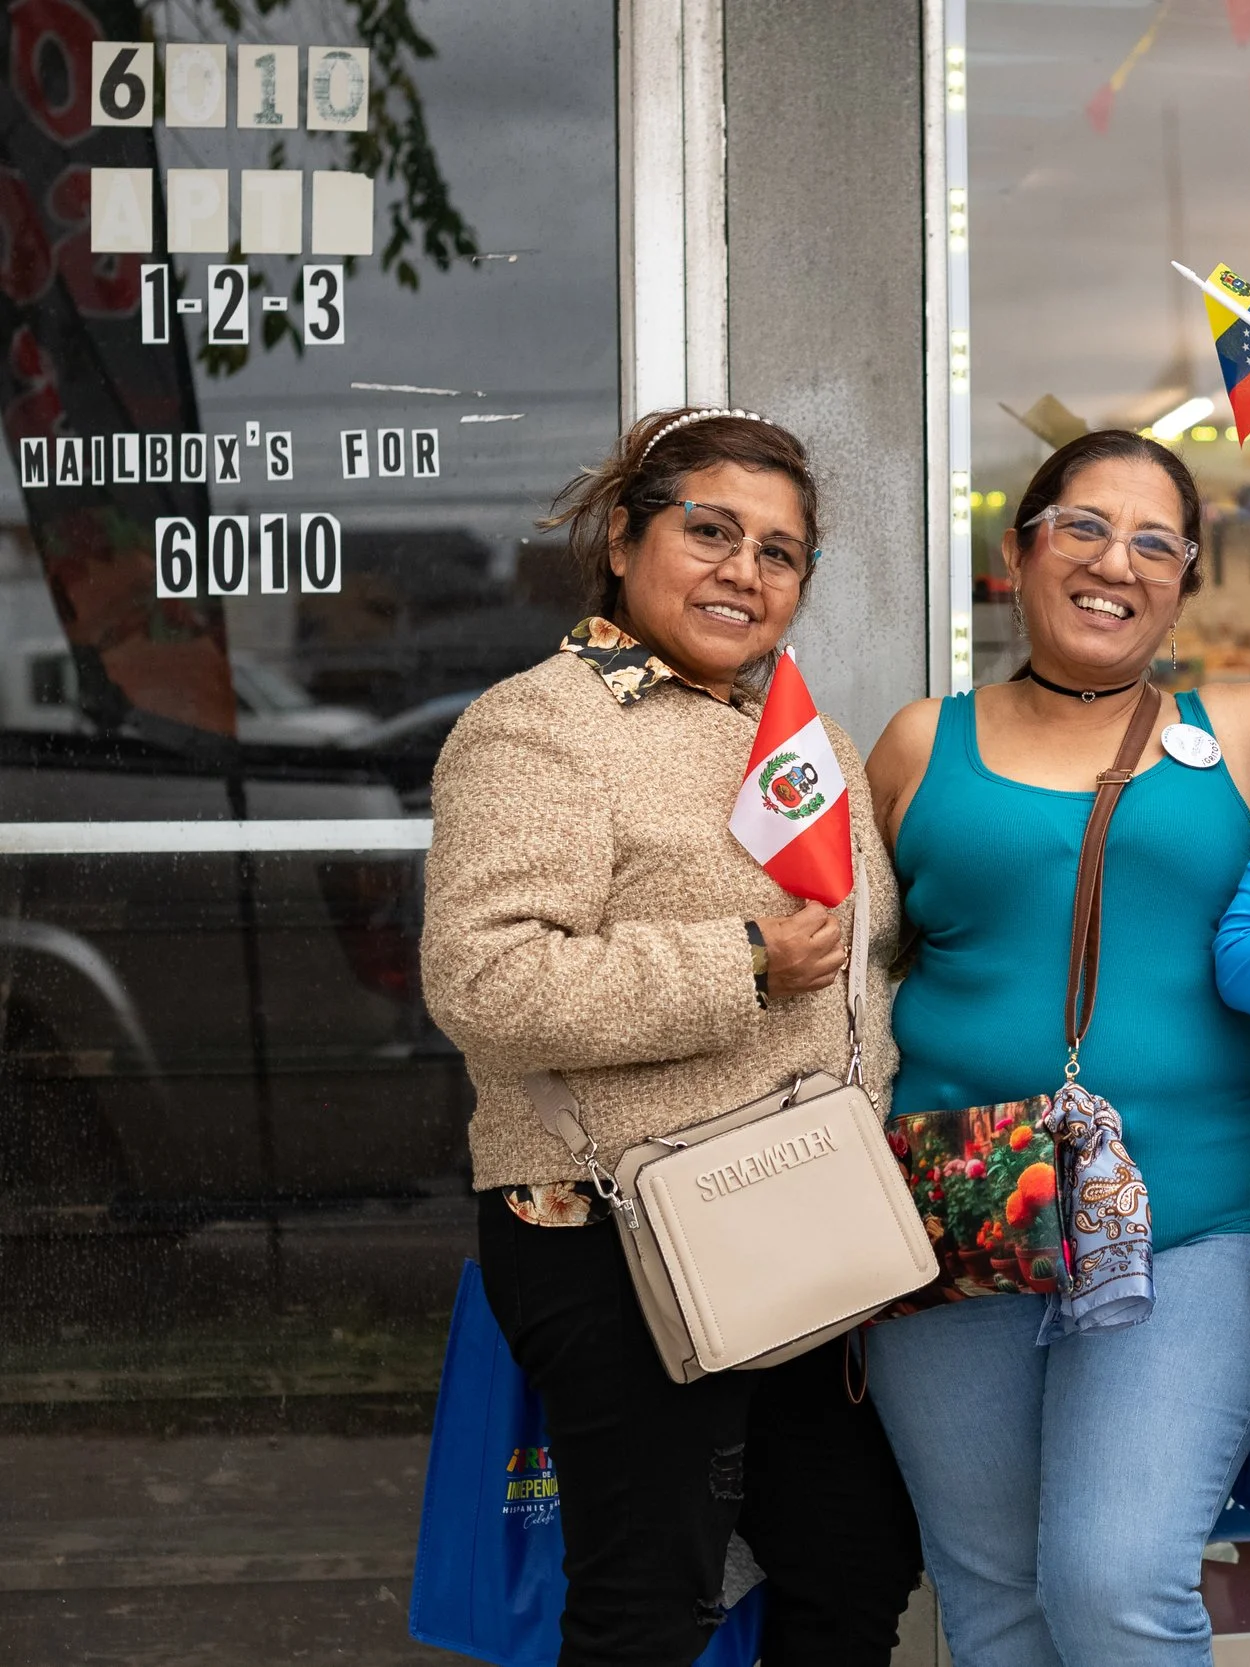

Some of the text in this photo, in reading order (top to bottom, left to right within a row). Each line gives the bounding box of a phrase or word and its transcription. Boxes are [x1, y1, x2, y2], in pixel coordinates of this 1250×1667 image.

[99, 48, 366, 125] 6010
[95, 172, 298, 250] APT
[144, 266, 341, 342] 1-2-3
[23, 429, 437, 484] MAILBOX'S FOR
[159, 515, 338, 593] 6010
[502, 1504, 545, 1514] HISPANIC
